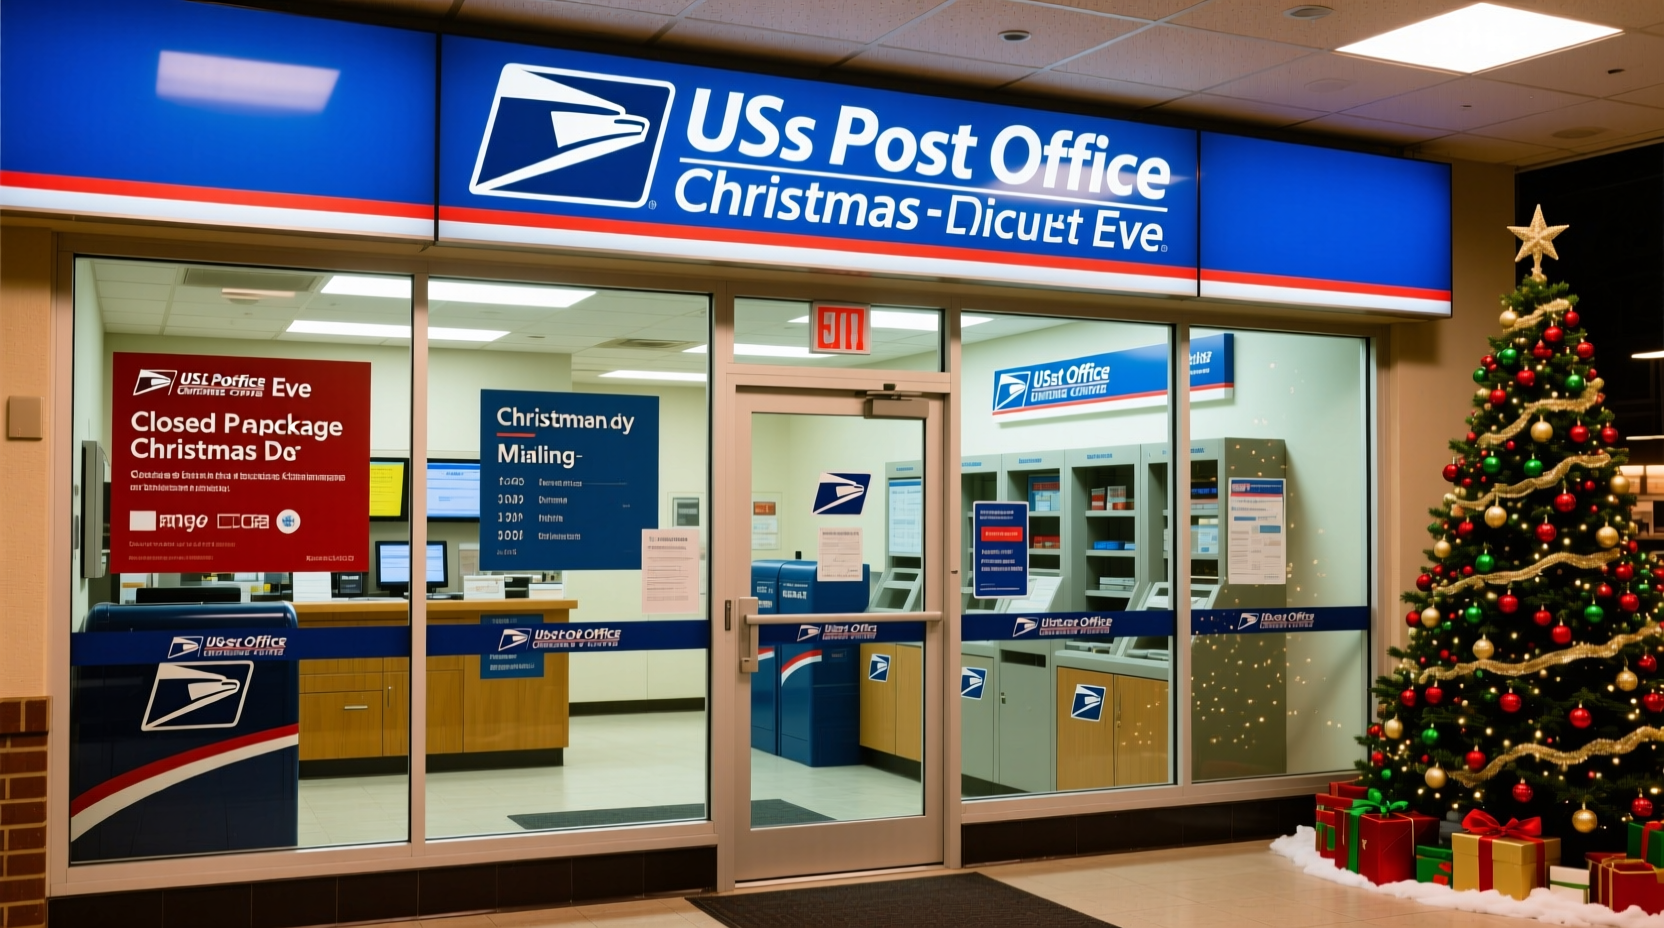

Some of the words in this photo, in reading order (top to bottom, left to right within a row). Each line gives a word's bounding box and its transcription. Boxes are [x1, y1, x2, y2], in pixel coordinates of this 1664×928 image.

[687, 88, 816, 162] USs
[829, 105, 978, 180] Post
[990, 125, 1171, 200] Office
[675, 168, 921, 231] Christmas
[1092, 209, 1164, 252] Eve
[1066, 362, 1110, 384] Office
[272, 377, 312, 398] Eve
[131, 411, 216, 434] Closed
[130, 437, 257, 461] Christmas
